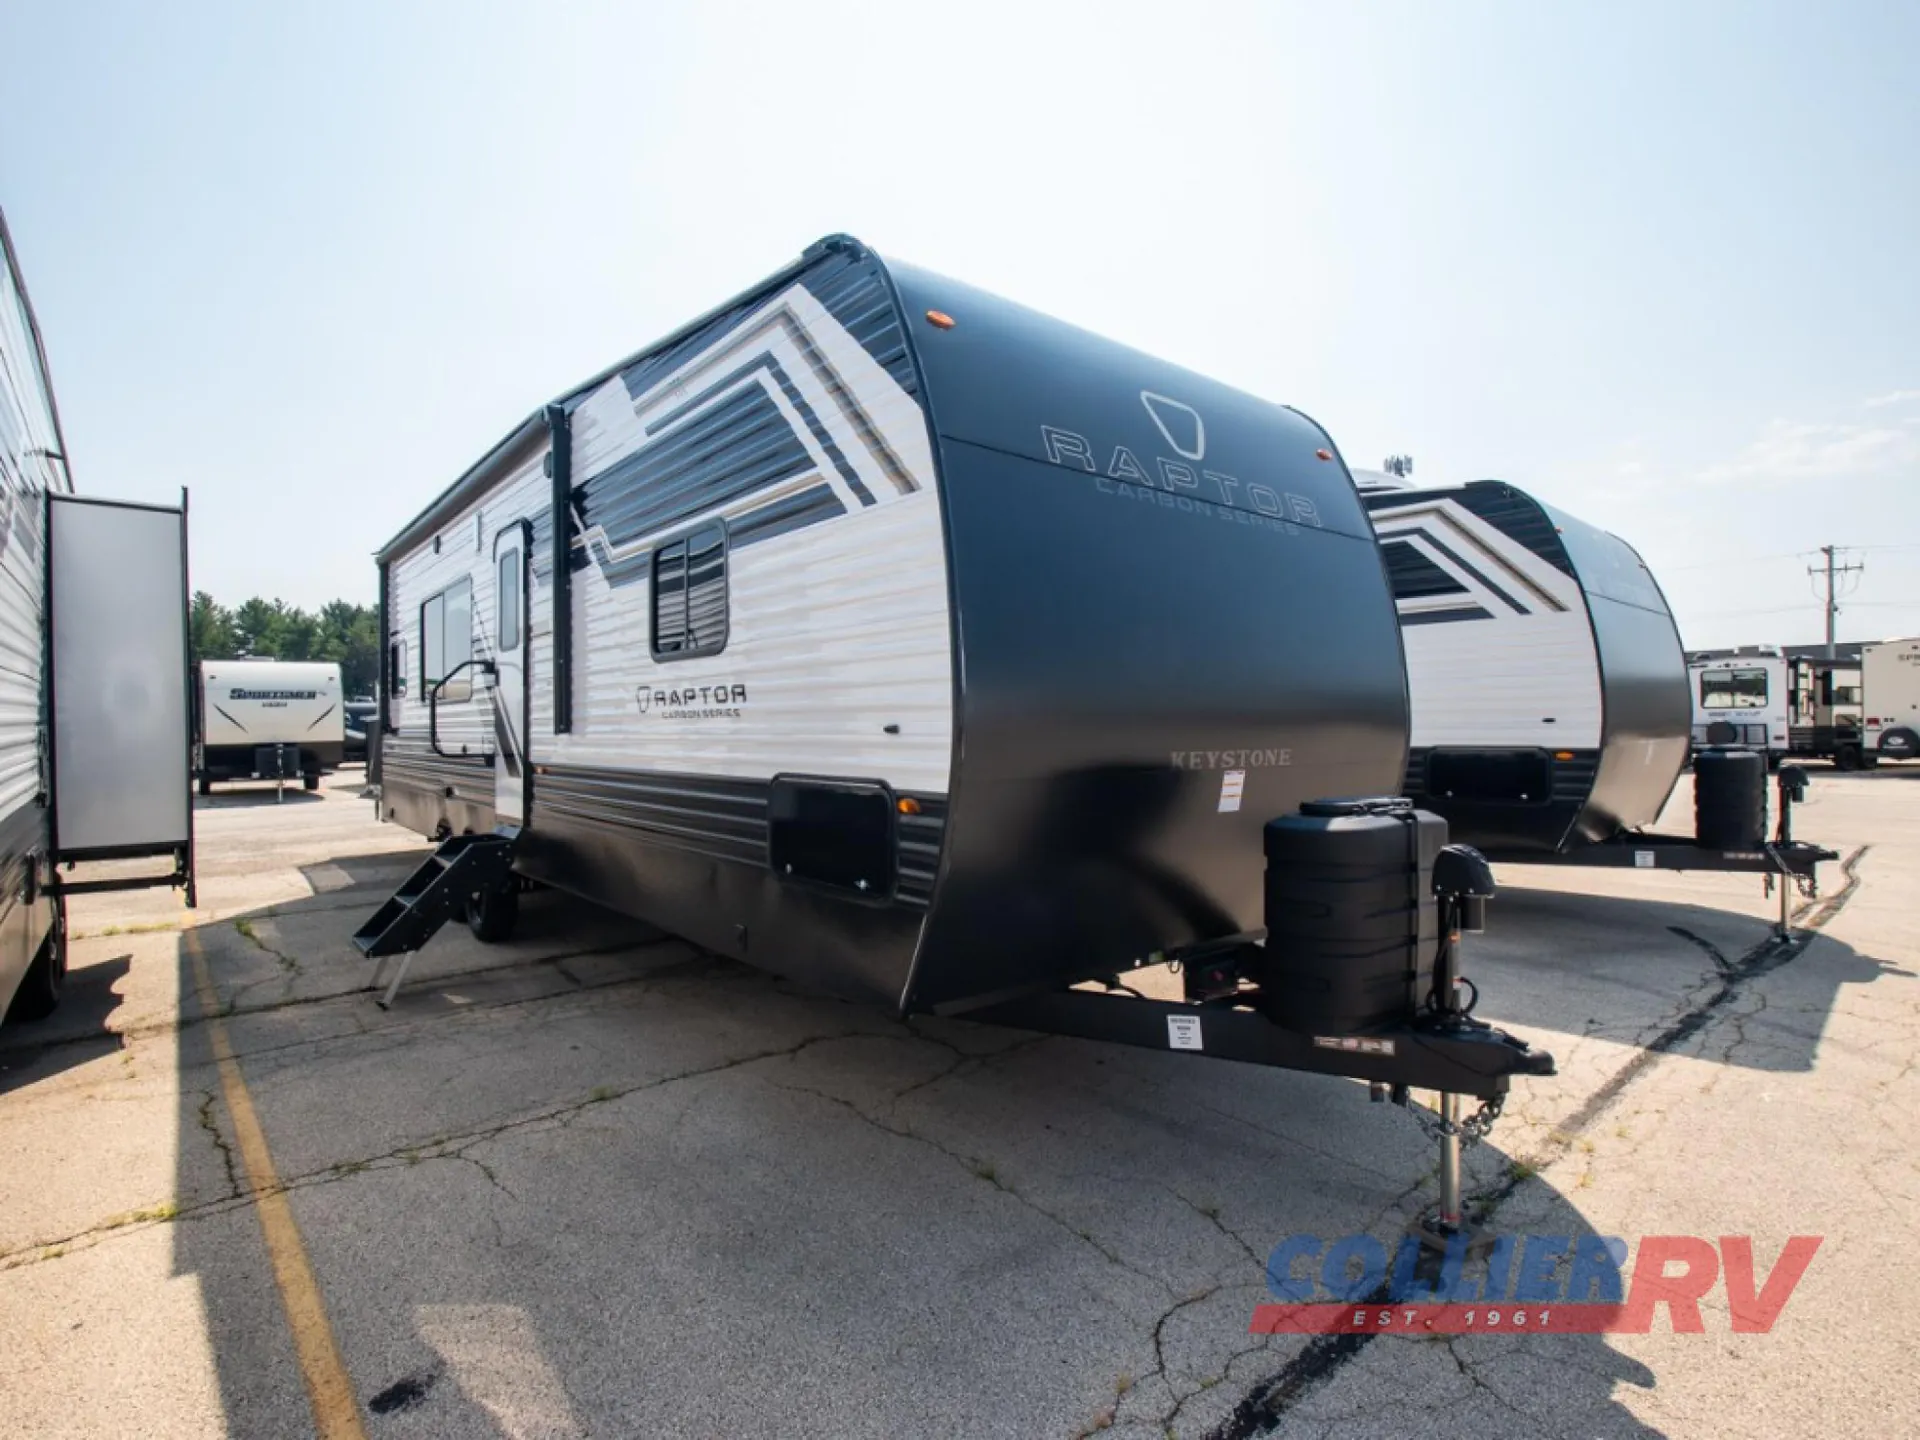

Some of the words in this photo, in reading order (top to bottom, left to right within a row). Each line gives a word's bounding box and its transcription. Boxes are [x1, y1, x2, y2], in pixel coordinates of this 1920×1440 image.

[1041, 424, 1323, 528] RAPTOR
[1096, 478, 1211, 517] CARBON
[1217, 506, 1300, 536] SERIES
[654, 684, 747, 706] RAPTOR
[1171, 749, 1293, 770] KEYSTONE
